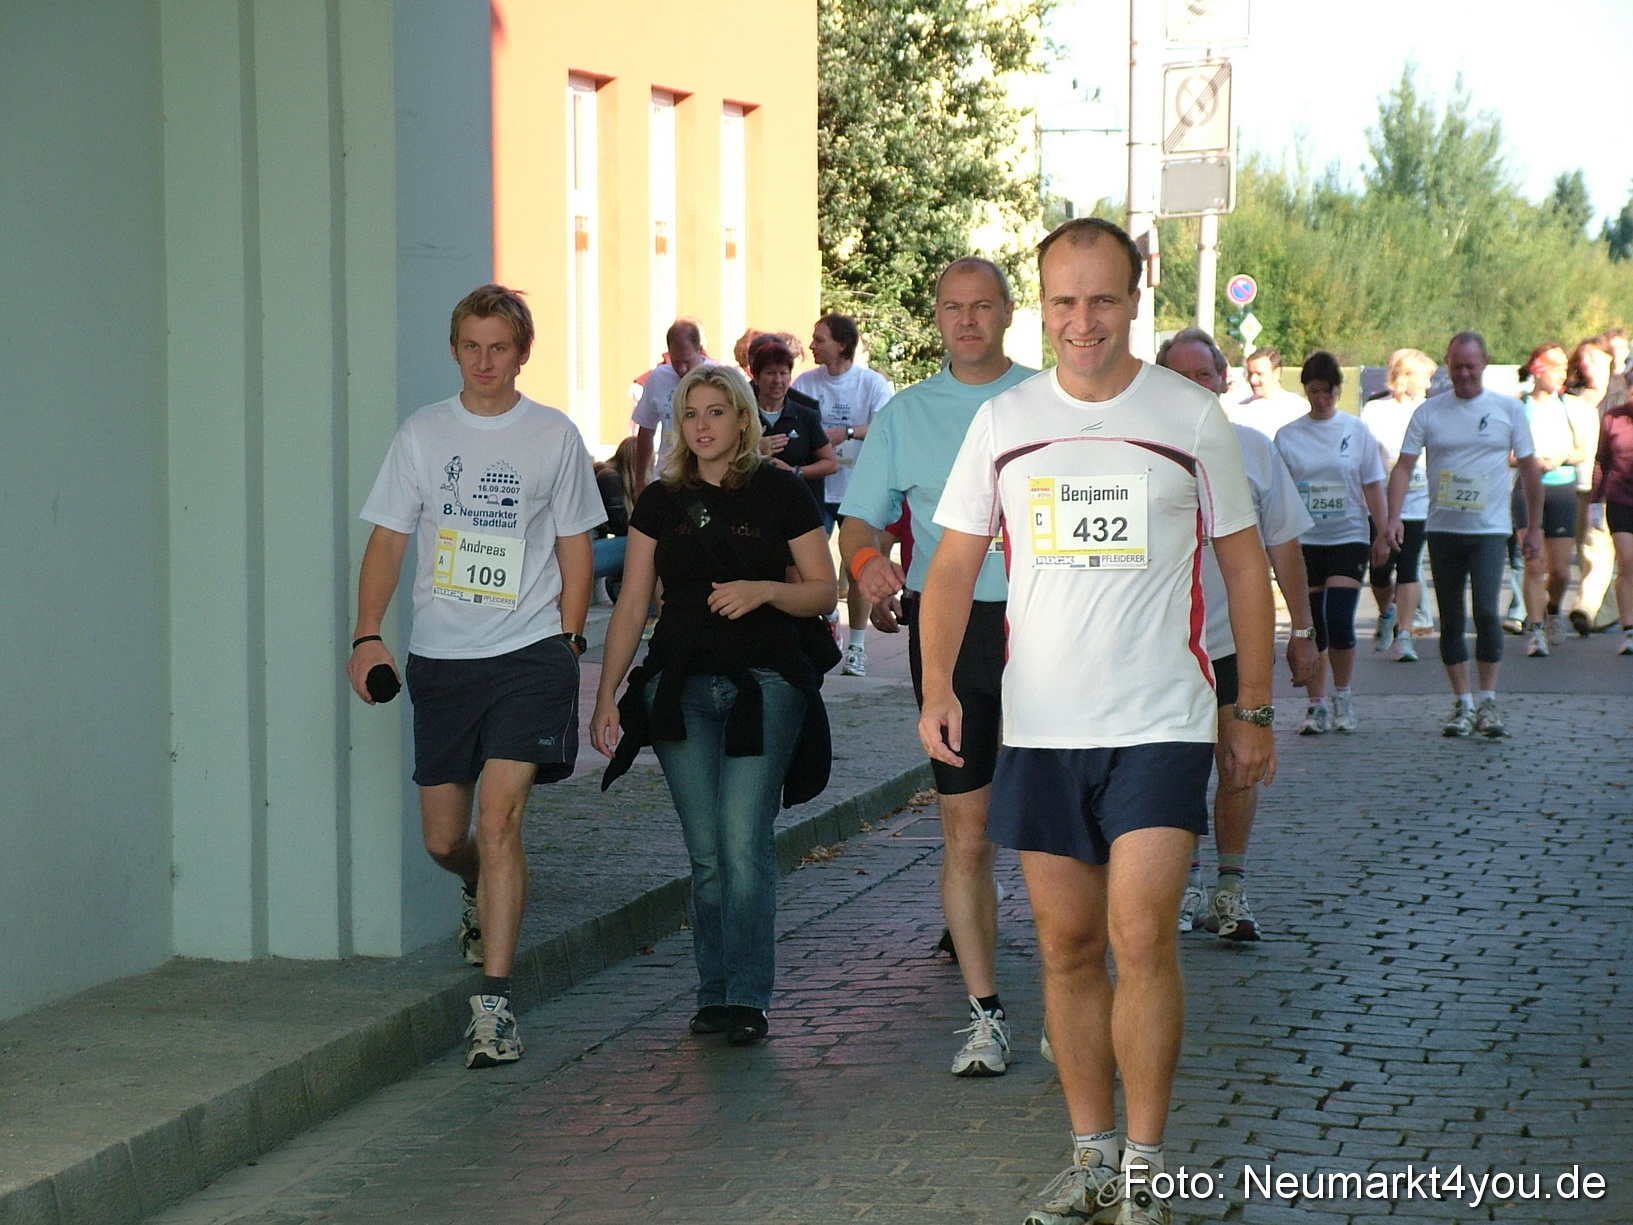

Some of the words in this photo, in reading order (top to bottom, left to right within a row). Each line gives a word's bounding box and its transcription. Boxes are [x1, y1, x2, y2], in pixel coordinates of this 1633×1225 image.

[478, 485, 520, 494] 16.09.2007
[1061, 484, 1128, 505] Benjamin
[1456, 490, 1480, 501] 227
[1312, 498, 1343, 509] 2548
[443, 503, 456, 515] 8.
[460, 507, 517, 519] Neumarkter
[473, 517, 517, 528] Stadtlauf
[1035, 512, 1042, 525] C
[1073, 516, 1128, 542] 432
[459, 537, 506, 557] Andreas
[438, 555, 444, 565] A
[1102, 555, 1145, 563] PFLEIDERER
[466, 564, 506, 587] 109
[483, 595, 516, 605] PFLEIDERER
